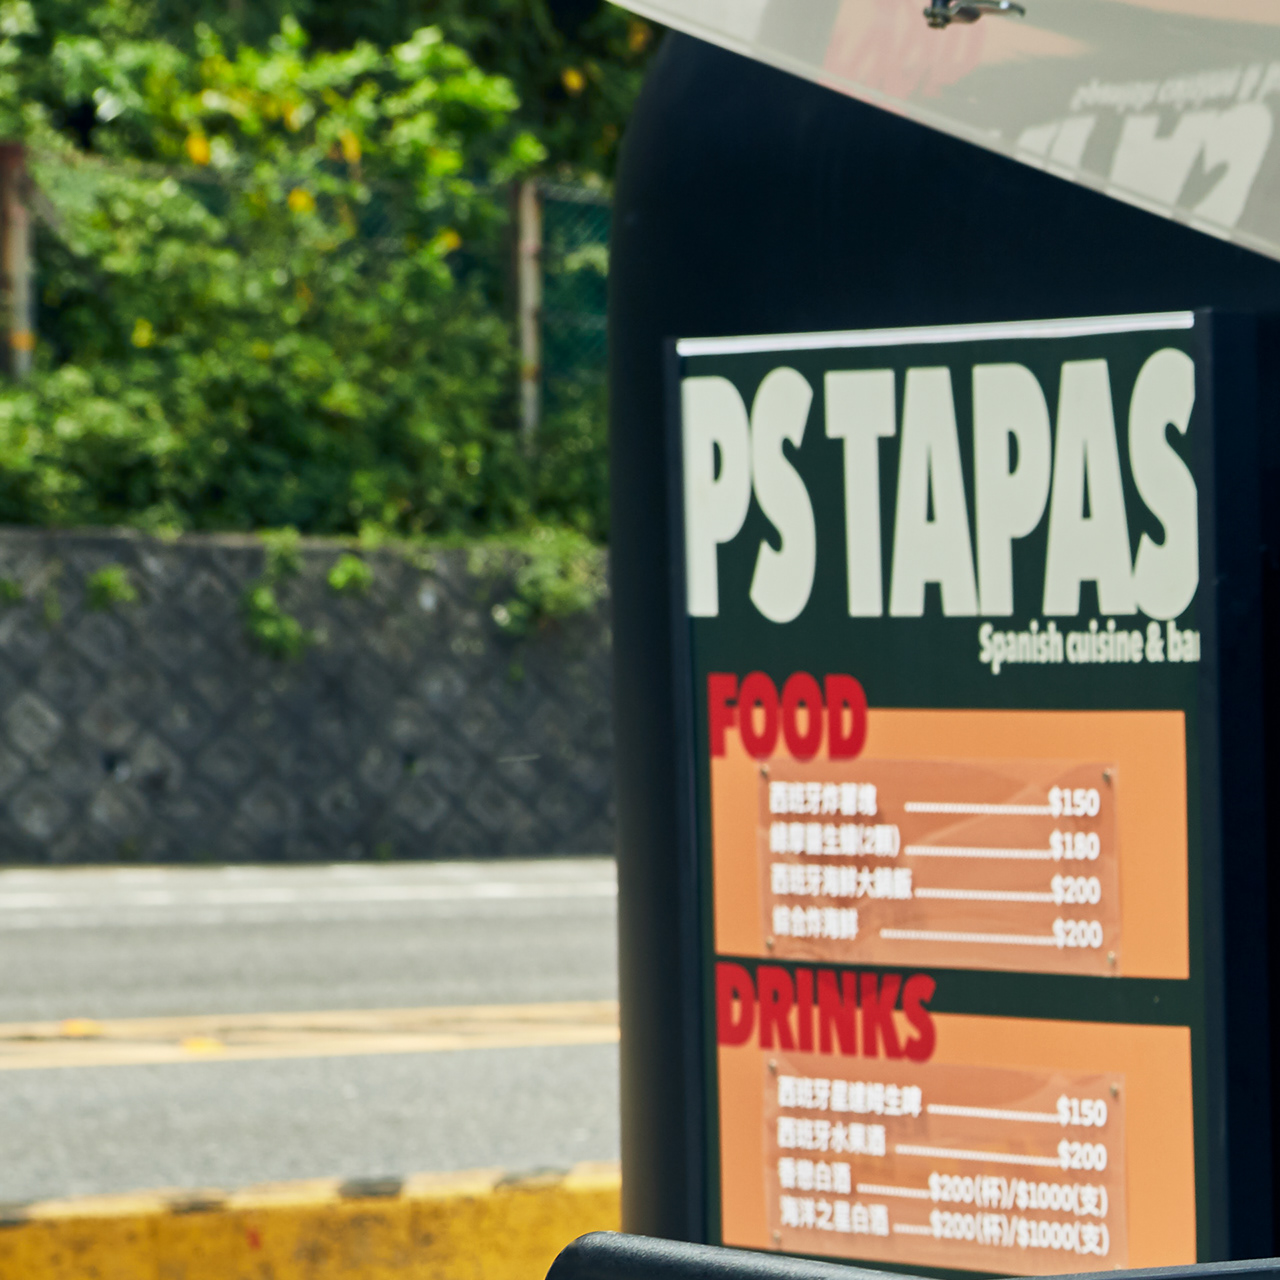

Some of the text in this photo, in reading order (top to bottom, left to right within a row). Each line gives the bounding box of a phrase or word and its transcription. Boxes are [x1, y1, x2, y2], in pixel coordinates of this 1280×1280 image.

[681, 348, 1199, 623] PS TAPAS
[979, 618, 1064, 675] Spanish
[1066, 618, 1143, 663] cuisine
[1145, 620, 1165, 663] &
[708, 671, 868, 762] FOOD
[1048, 785, 1100, 818] $150
[1051, 873, 1101, 906] $200
[1052, 917, 1103, 949] $200
[715, 962, 936, 1063] DRINKS
[1057, 1094, 1107, 1127] $150
[777, 1117, 1107, 1171] 西班牙水果酒 $200
